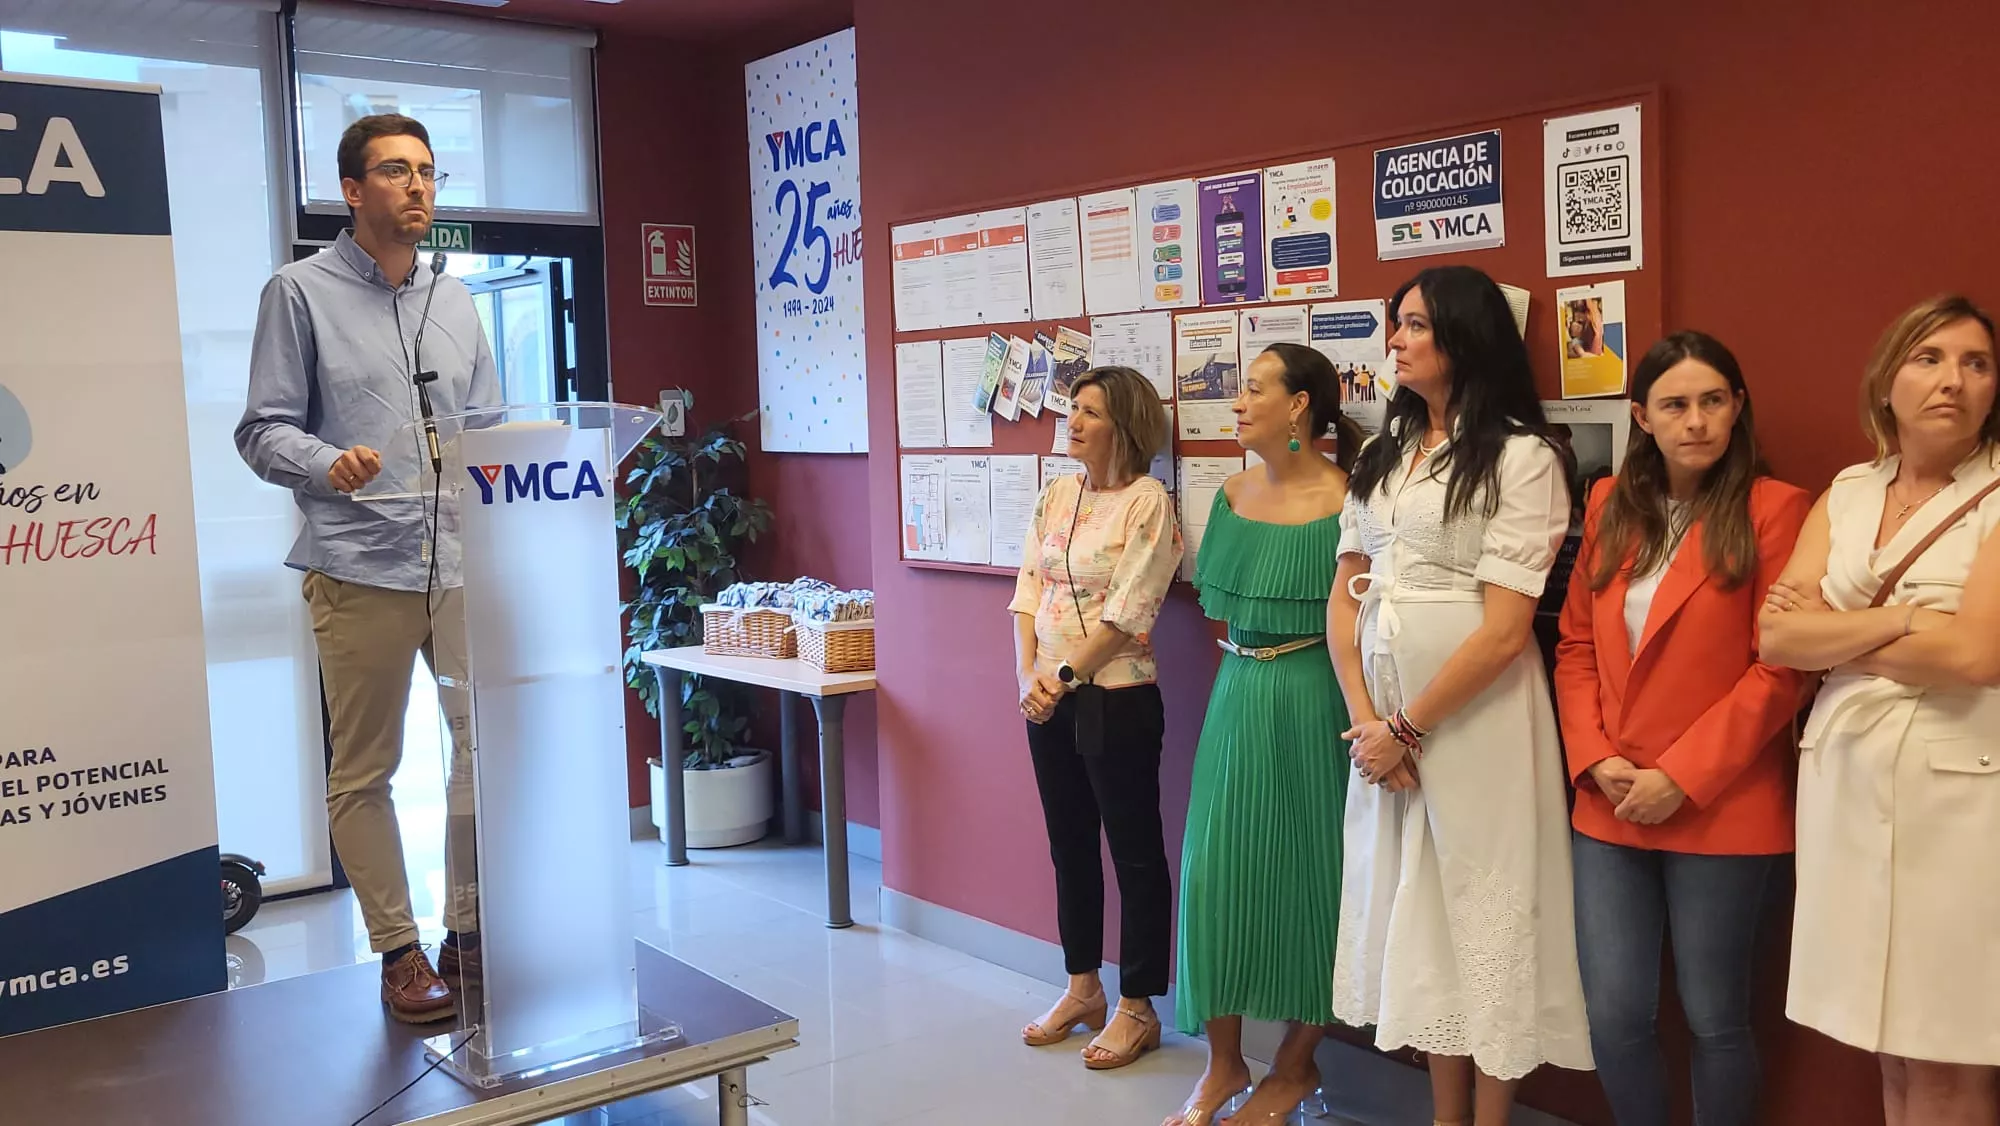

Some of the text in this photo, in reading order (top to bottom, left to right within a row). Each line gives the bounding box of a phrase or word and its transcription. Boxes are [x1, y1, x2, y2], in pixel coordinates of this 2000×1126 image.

[766, 118, 846, 172] YMCA
[1386, 141, 1488, 177] AGENCIA DE
[1381, 163, 1493, 200] COLOCACIÓN
[827, 198, 853, 220] años
[1416, 194, 1469, 212] 9900000145
[769, 179, 832, 295] 25
[1429, 212, 1493, 241] YMCA
[647, 285, 694, 299] EXTINTOR
[783, 299, 803, 318] 1999
[812, 296, 835, 315] 2024
[1051, 396, 1067, 407] YMCA
[971, 460, 987, 469] YMCA
[54, 482, 101, 505] en
[467, 460, 605, 505] YMCA
[0, 513, 157, 565] HUESCA
[0, 746, 57, 770] ARA
[2, 758, 169, 799] EL POTENCIAL
[39, 802, 55, 820] Y
[61, 784, 168, 817] JÓVENES
